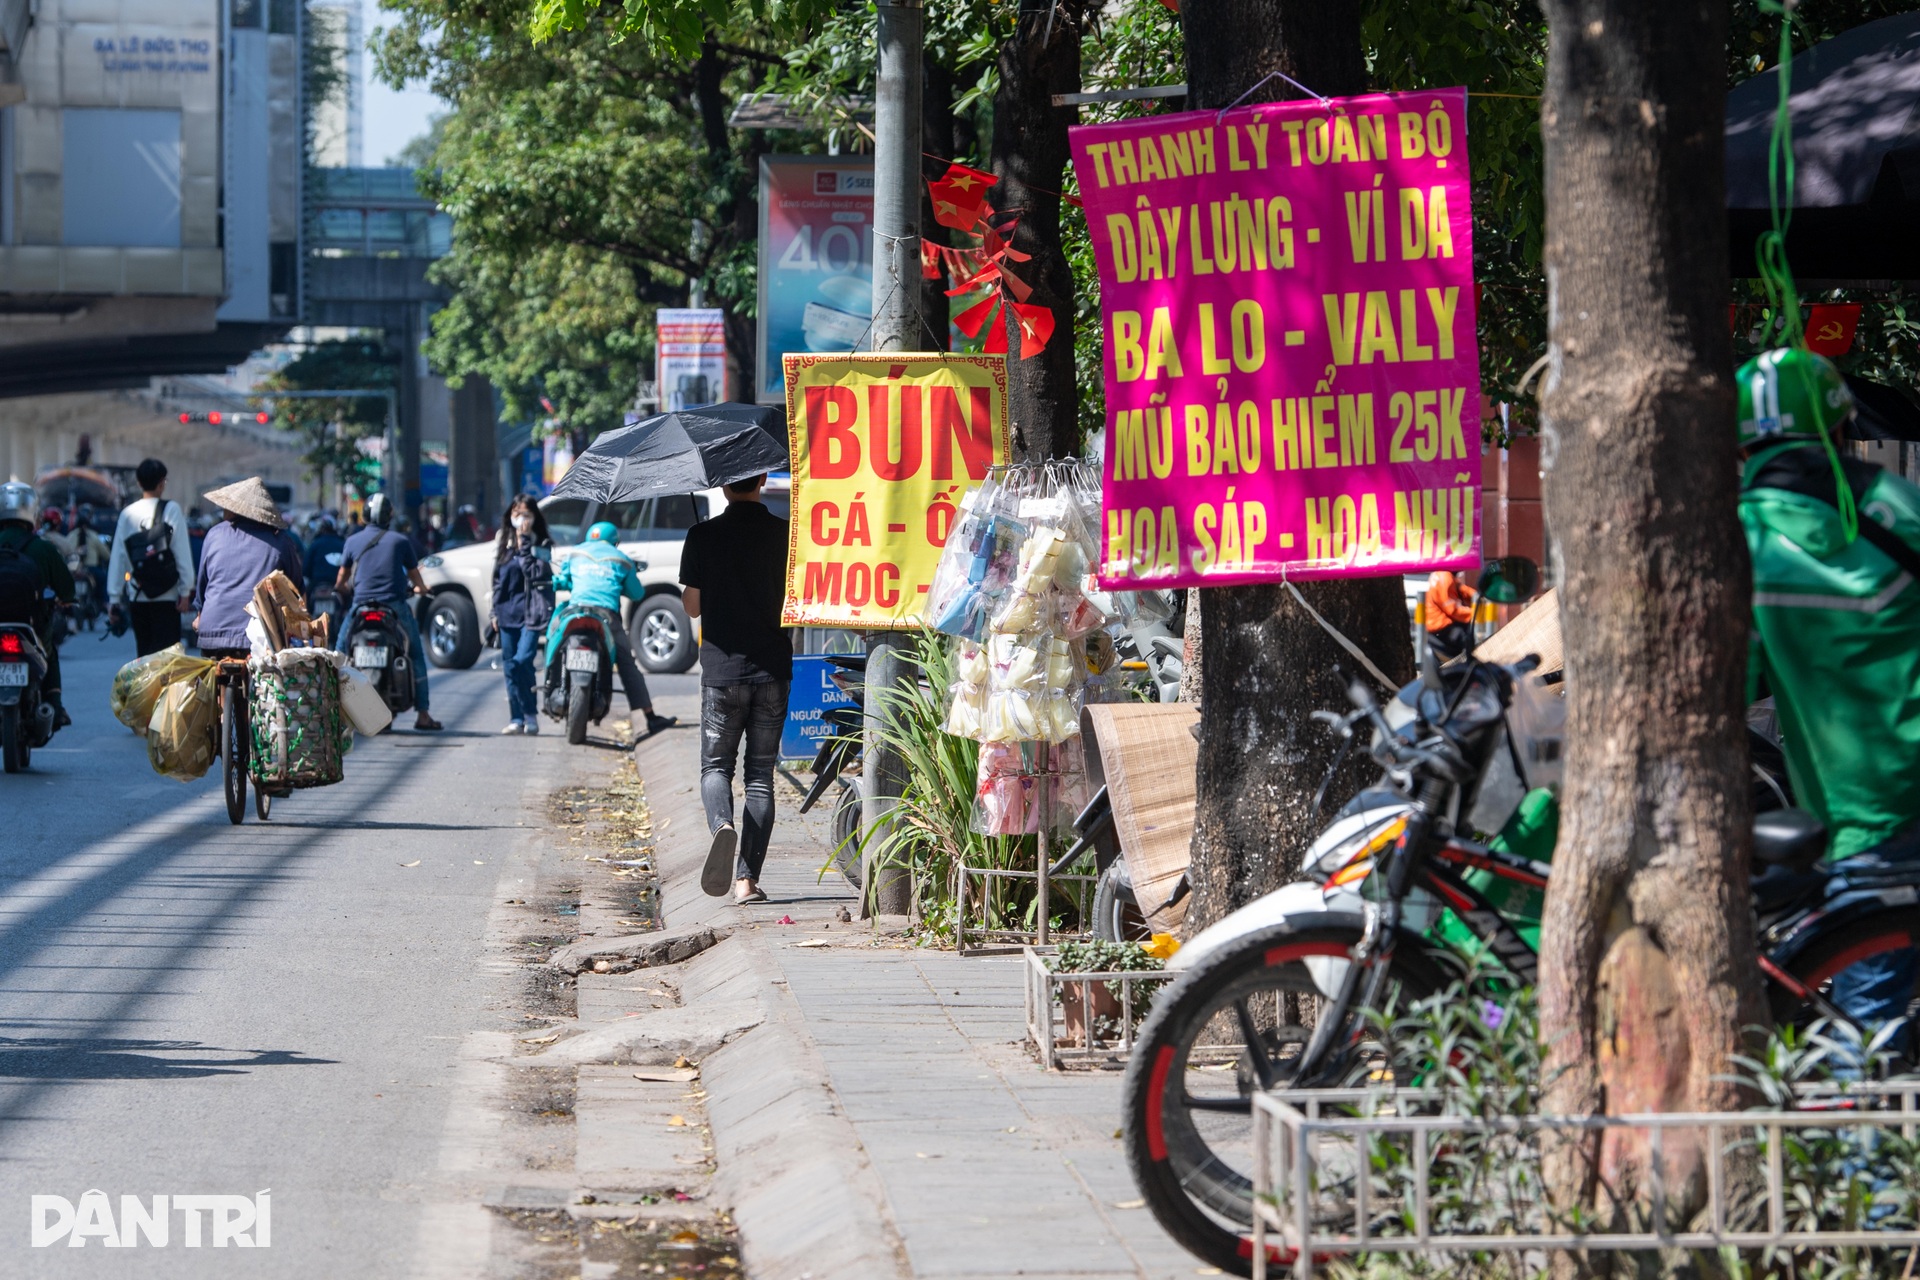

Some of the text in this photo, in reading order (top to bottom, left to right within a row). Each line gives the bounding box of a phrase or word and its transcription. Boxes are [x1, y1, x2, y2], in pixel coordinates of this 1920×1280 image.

[1086, 99, 1452, 188] THANH LÝ TOÀN BỘ
[1107, 195, 1181, 283] DÂY
[1190, 192, 1295, 275] LƯNG
[1345, 174, 1386, 263] VÍ
[1400, 185, 1454, 261] DA
[1112, 307, 1184, 382] BA
[1198, 300, 1266, 375] LO
[1322, 286, 1460, 366] VALY
[804, 365, 994, 481] BÚN
[1113, 364, 1467, 482] MŨ BẢO HIỂM 25K
[810, 491, 872, 547] CÁ
[926, 485, 959, 548] Ố
[1107, 505, 1179, 578] HOA
[1192, 486, 1267, 576] SÁP
[1305, 493, 1383, 568] HOA
[1394, 471, 1474, 560] NHŨ
[803, 561, 900, 616] MỌC
[790, 707, 824, 721] NGƯỜ
